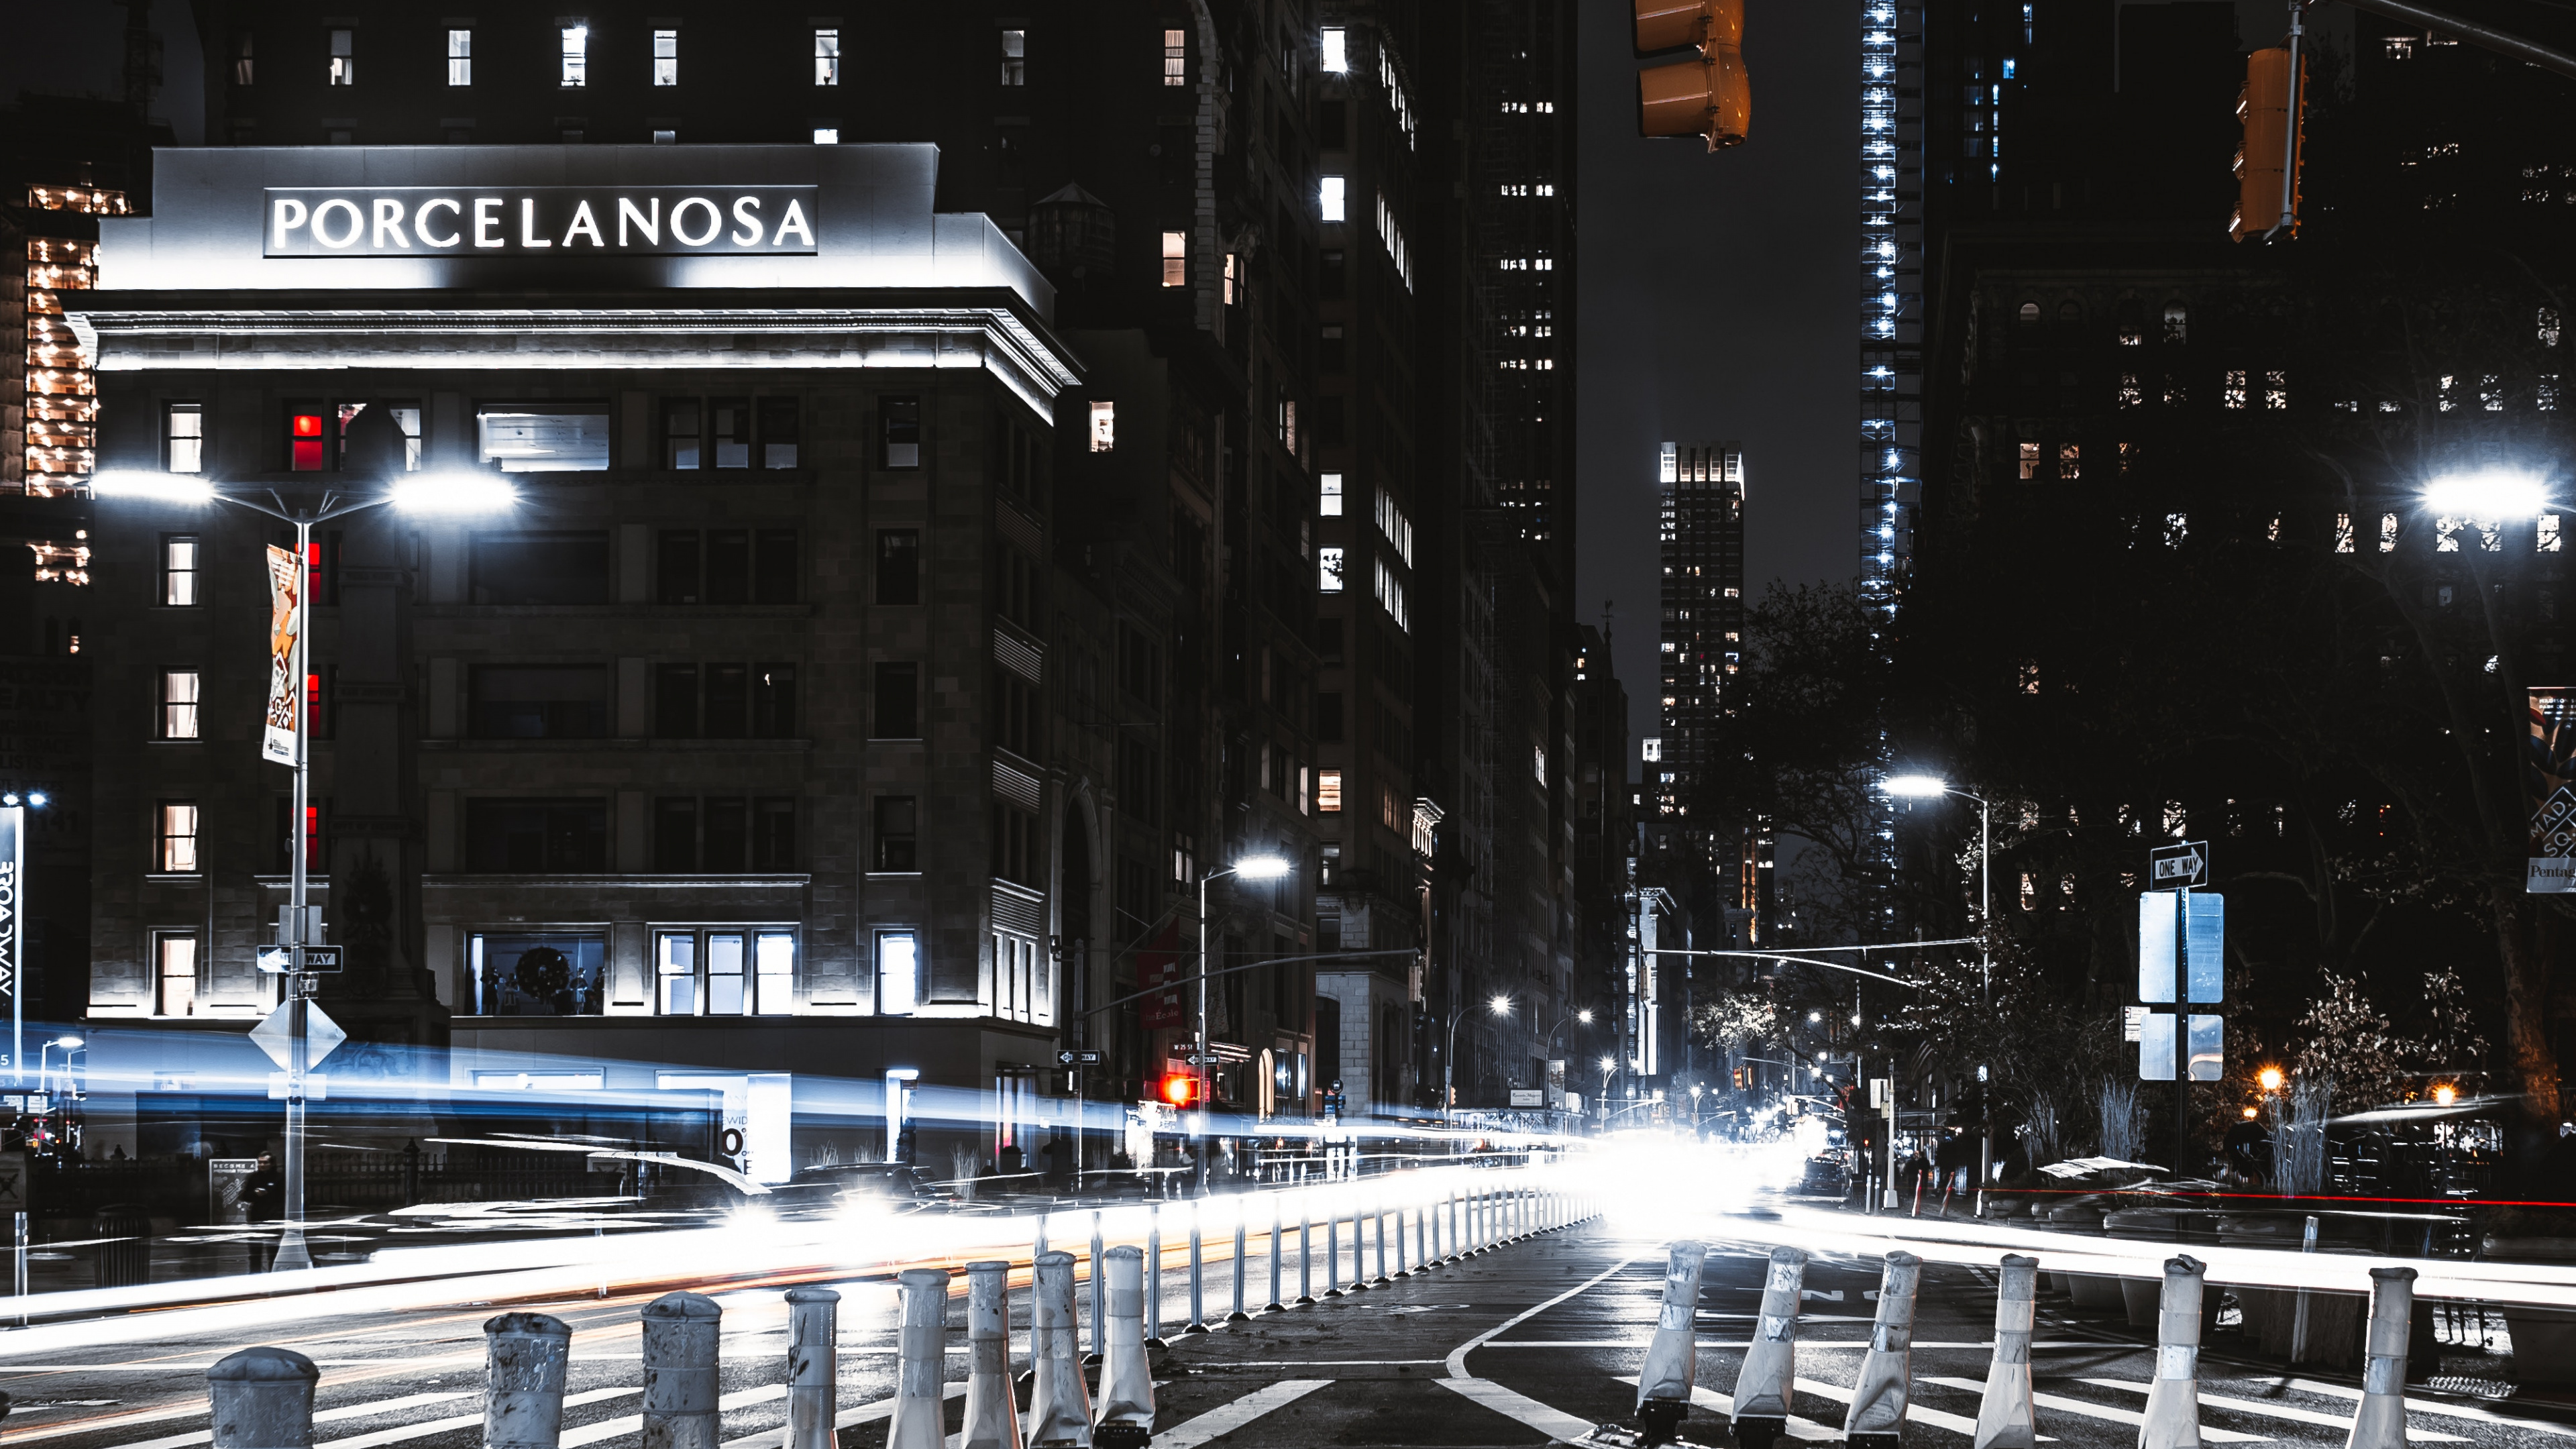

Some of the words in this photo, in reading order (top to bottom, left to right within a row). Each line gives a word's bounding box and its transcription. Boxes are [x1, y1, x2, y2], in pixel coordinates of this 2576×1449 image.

[272, 197, 815, 249] PORCELANOSA
[2159, 859, 2176, 877] ONE
[2182, 857, 2198, 874] WAY
[306, 954, 331, 964] WAY
